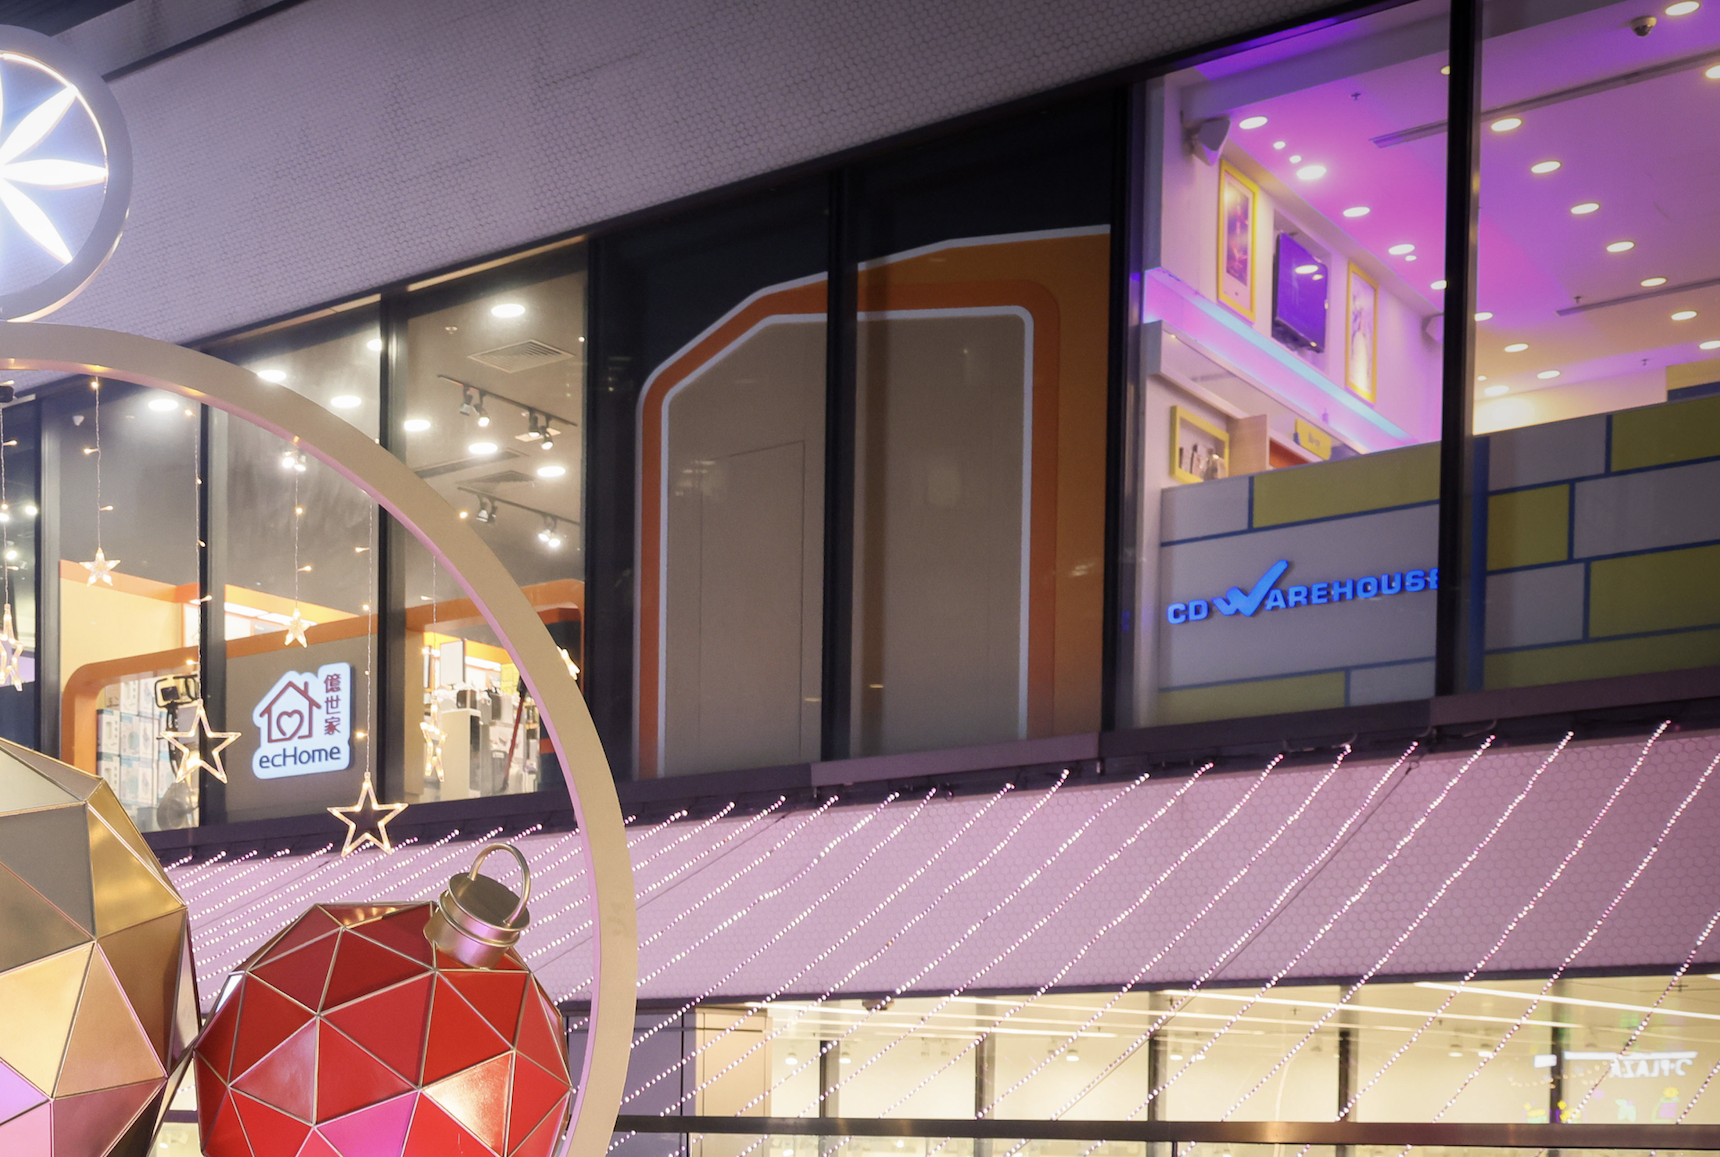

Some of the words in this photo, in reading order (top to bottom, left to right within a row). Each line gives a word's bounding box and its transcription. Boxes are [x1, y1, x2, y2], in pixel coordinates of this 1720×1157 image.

[1166, 598, 1209, 625] CD
[324, 673, 342, 736] 億世家
[259, 746, 341, 769] ecHome
